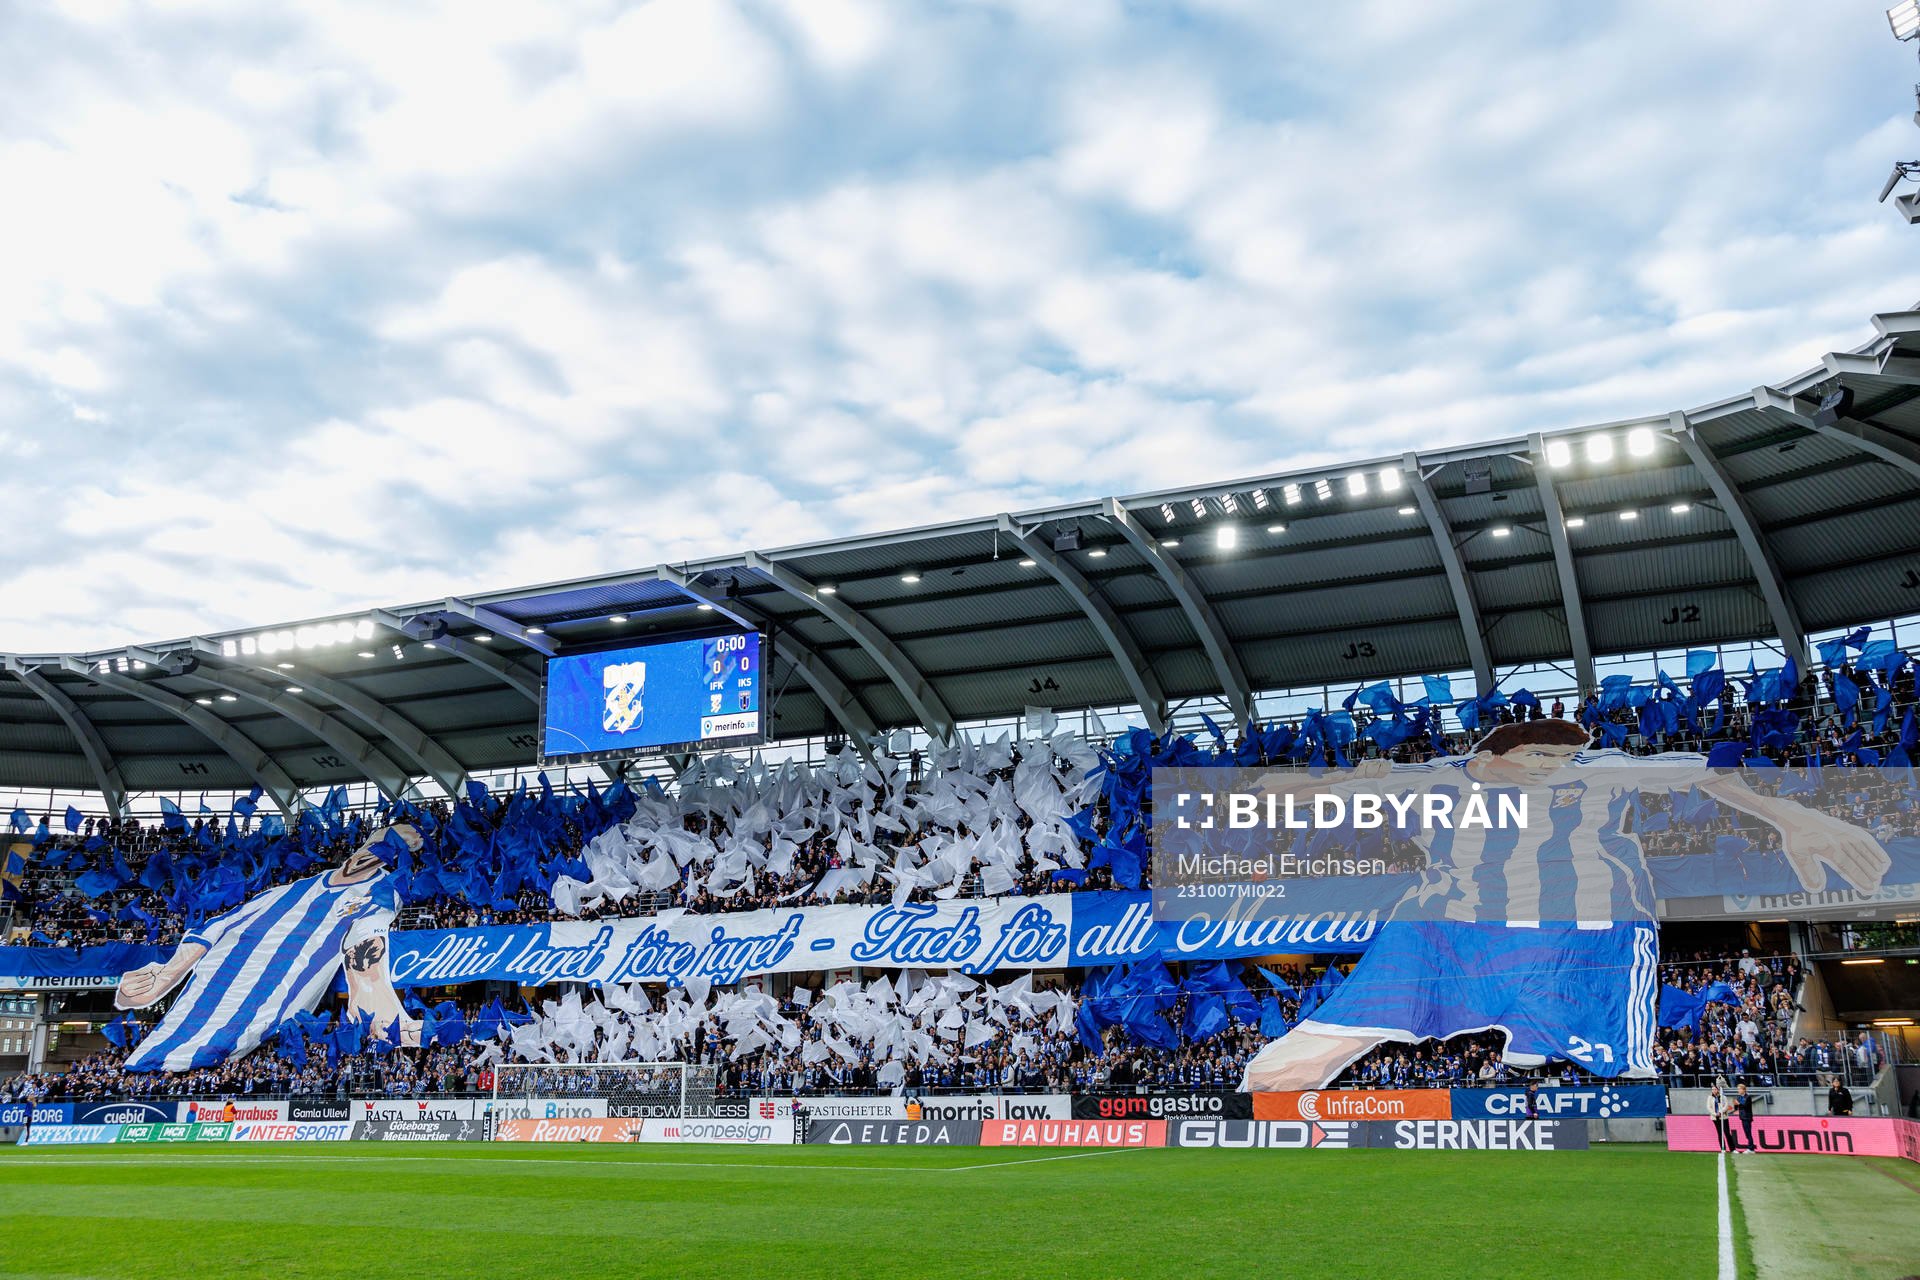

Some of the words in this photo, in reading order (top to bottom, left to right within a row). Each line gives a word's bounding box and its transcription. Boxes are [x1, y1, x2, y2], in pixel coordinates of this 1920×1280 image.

[1662, 605, 1700, 624] J2
[717, 636, 746, 652] 0:00
[1343, 642, 1376, 659] J3
[713, 660, 721, 674] 0
[741, 657, 749, 671] 0
[709, 681, 724, 691] IFK
[738, 677, 752, 687] IKS
[1028, 677, 1060, 692] J4
[714, 720, 756, 732] merinfo.se
[507, 735, 537, 748] H3
[179, 762, 209, 774] H1
[312, 756, 346, 769] H2
[390, 933, 504, 980] Alltid
[505, 925, 611, 987] laget
[588, 923, 698, 987] före
[667, 912, 804, 986] jaget
[850, 902, 982, 964] Tack
[961, 902, 1067, 974] för
[1176, 891, 1380, 953] Marcus
[545, 1102, 593, 1119] Brixo
[808, 1105, 893, 1117] FASTIGHETER
[922, 1099, 995, 1121] morris
[1005, 1099, 1052, 1121] law.
[1326, 1095, 1405, 1115] InfraCom
[1484, 1092, 1596, 1115] CRAFT
[2, 1106, 63, 1123] GÖTBORG
[104, 1108, 145, 1124] cuebid
[198, 1106, 278, 1123] Bergarabuss
[293, 1108, 322, 1118] Gamla
[322, 1107, 348, 1118] Ullevi
[365, 1110, 404, 1121] RASTA
[418, 1110, 458, 1121] RASTA
[28, 1126, 107, 1142] EFFEKTIV
[127, 1127, 148, 1137] MCR
[163, 1127, 185, 1137] MCR
[202, 1126, 224, 1137] MCR
[249, 1125, 348, 1141] INTERSPORT
[389, 1121, 440, 1132] Göteborgs
[531, 1119, 604, 1142] Renova
[861, 1125, 950, 1143] ELEDA
[1002, 1124, 1144, 1143] BAUHAUS
[382, 1131, 450, 1140] Metallpartier
[1179, 1121, 1349, 1148] GUIDE
[1394, 1120, 1555, 1150] SERNEKE
